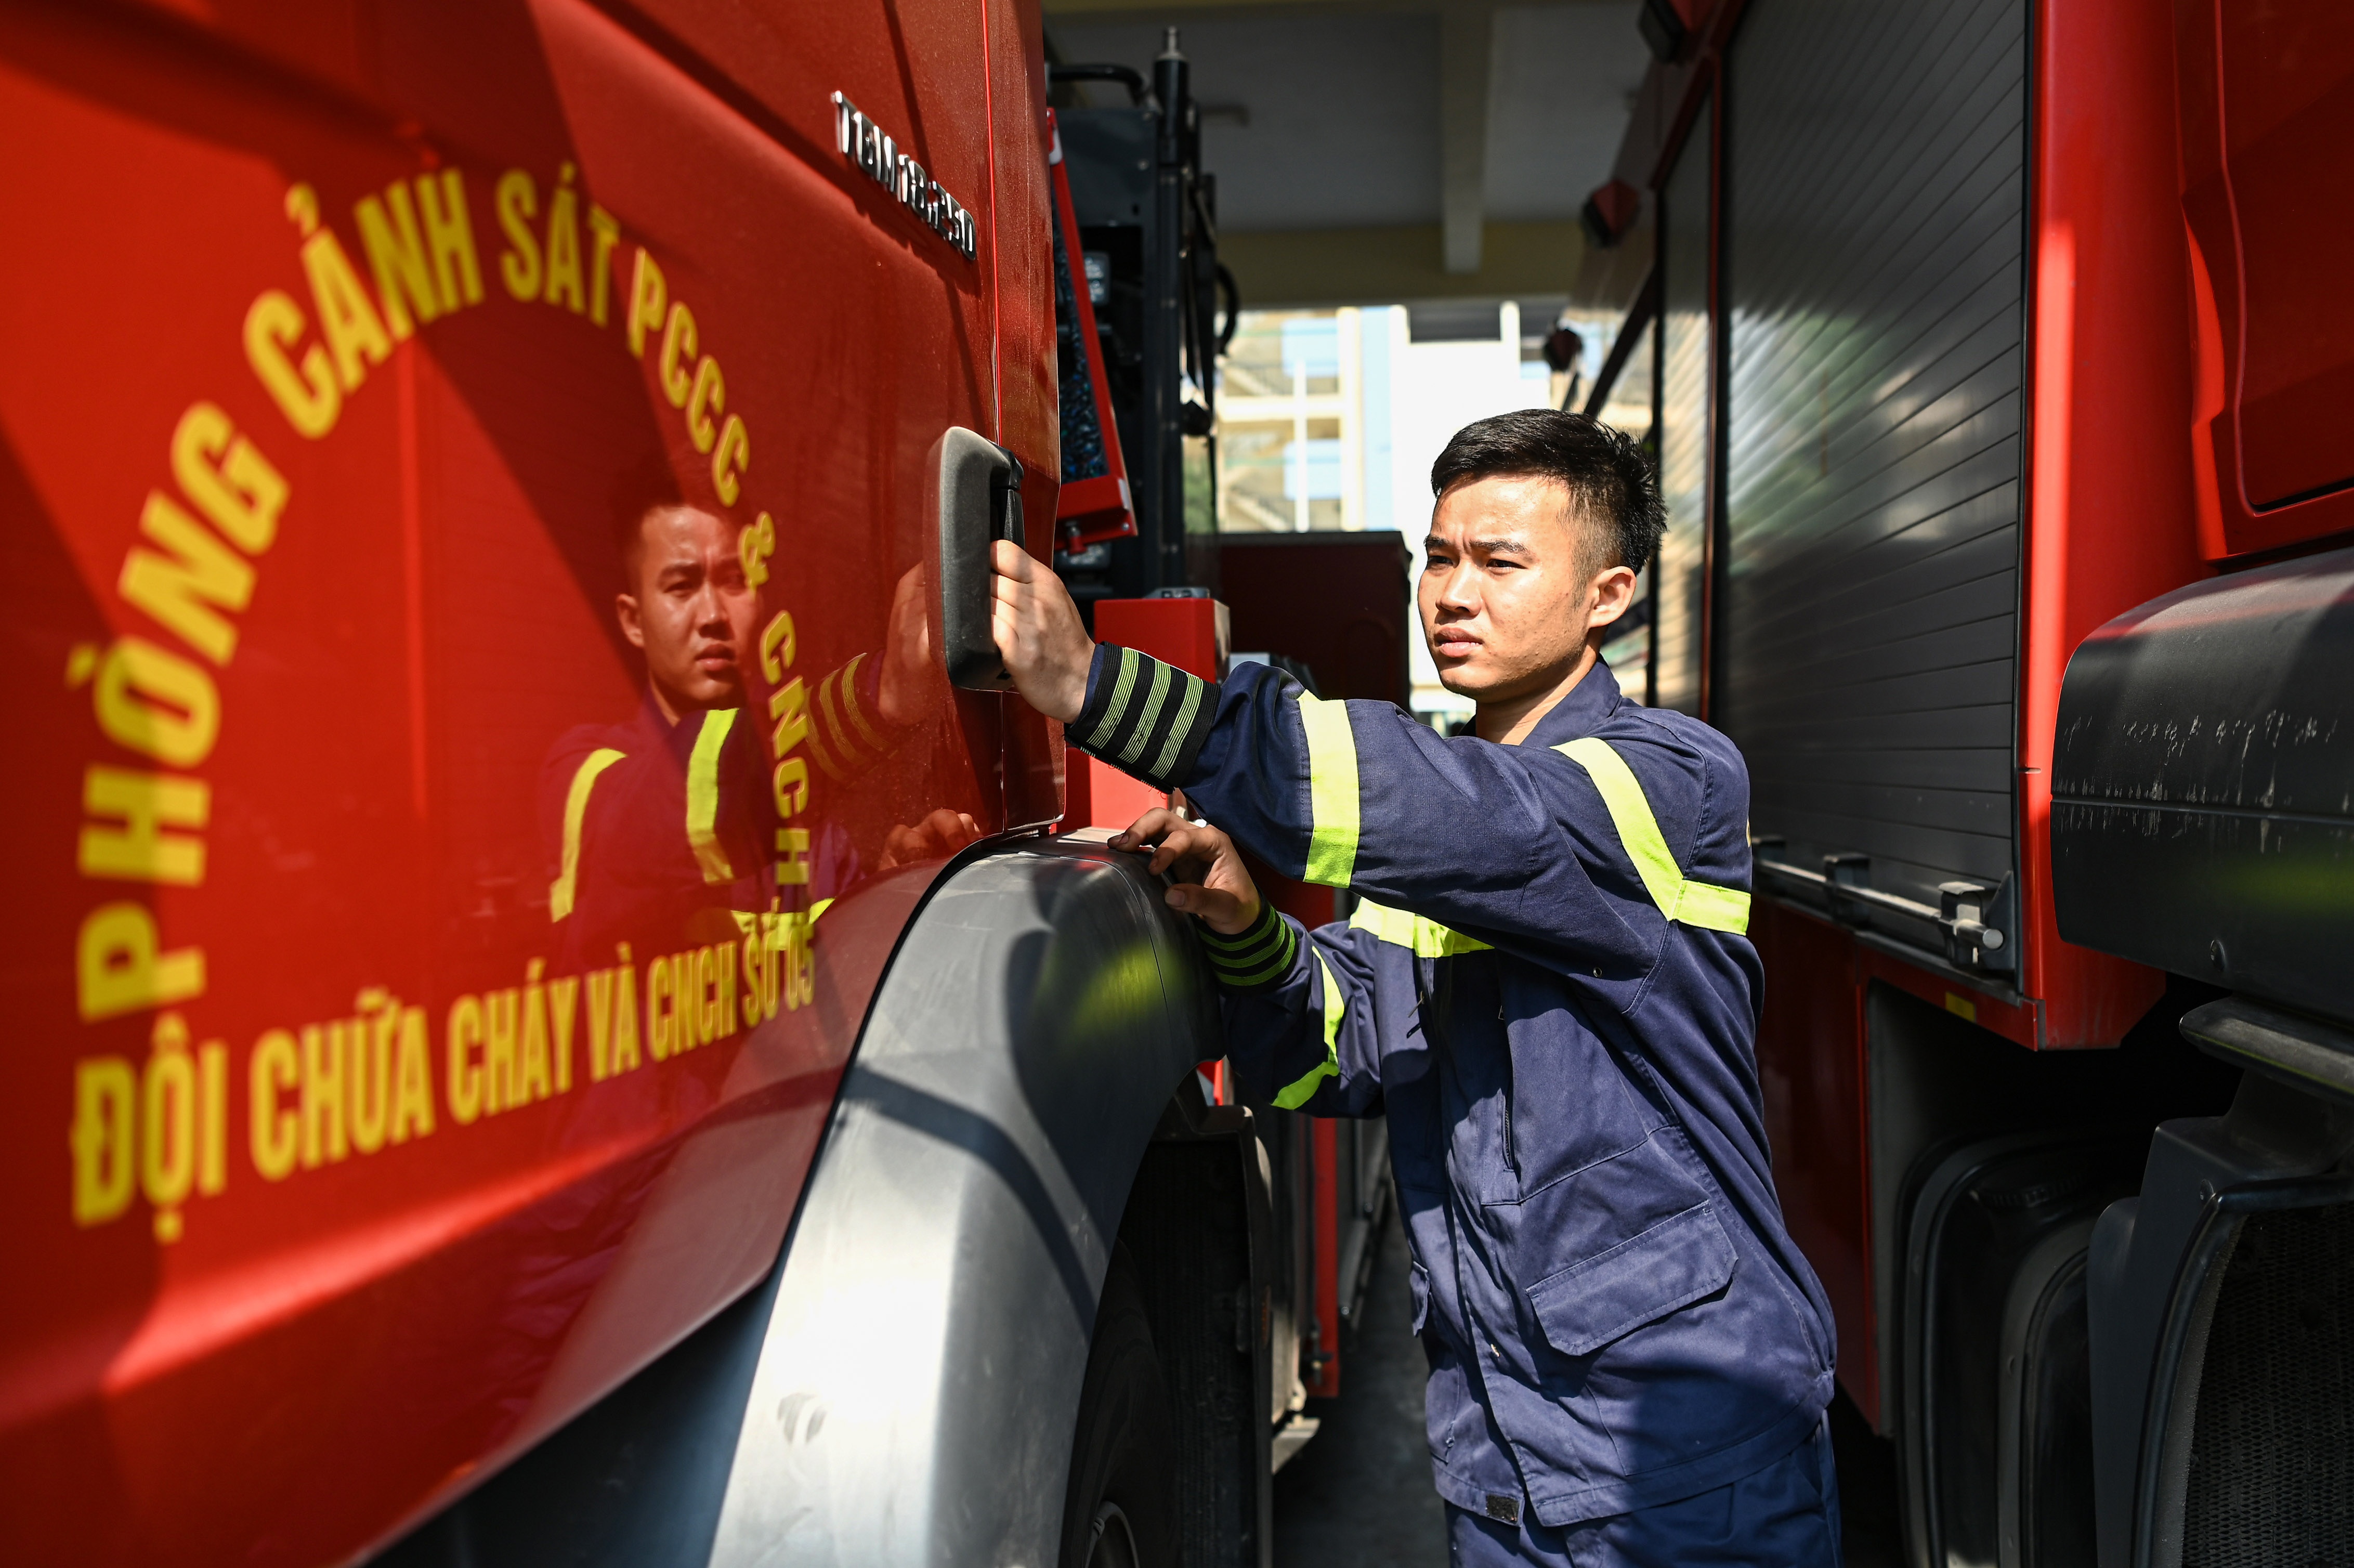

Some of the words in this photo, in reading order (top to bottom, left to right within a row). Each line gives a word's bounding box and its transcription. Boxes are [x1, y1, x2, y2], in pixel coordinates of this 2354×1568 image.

[66, 400, 290, 1011] PHÒNG
[243, 168, 483, 439] CẢNH
[496, 162, 621, 328] SÁT
[627, 246, 750, 506] PCCC
[738, 512, 775, 600] &
[760, 610, 810, 885] CNCH
[70, 1012, 228, 1243] ĐỘI
[249, 987, 435, 1181] CHỮA
[447, 957, 578, 1125] CHÁY
[586, 942, 642, 1083] VÀ
[647, 941, 737, 1062] CNCH
[741, 896, 780, 1027] SỐ
[784, 924, 815, 1011] 05
